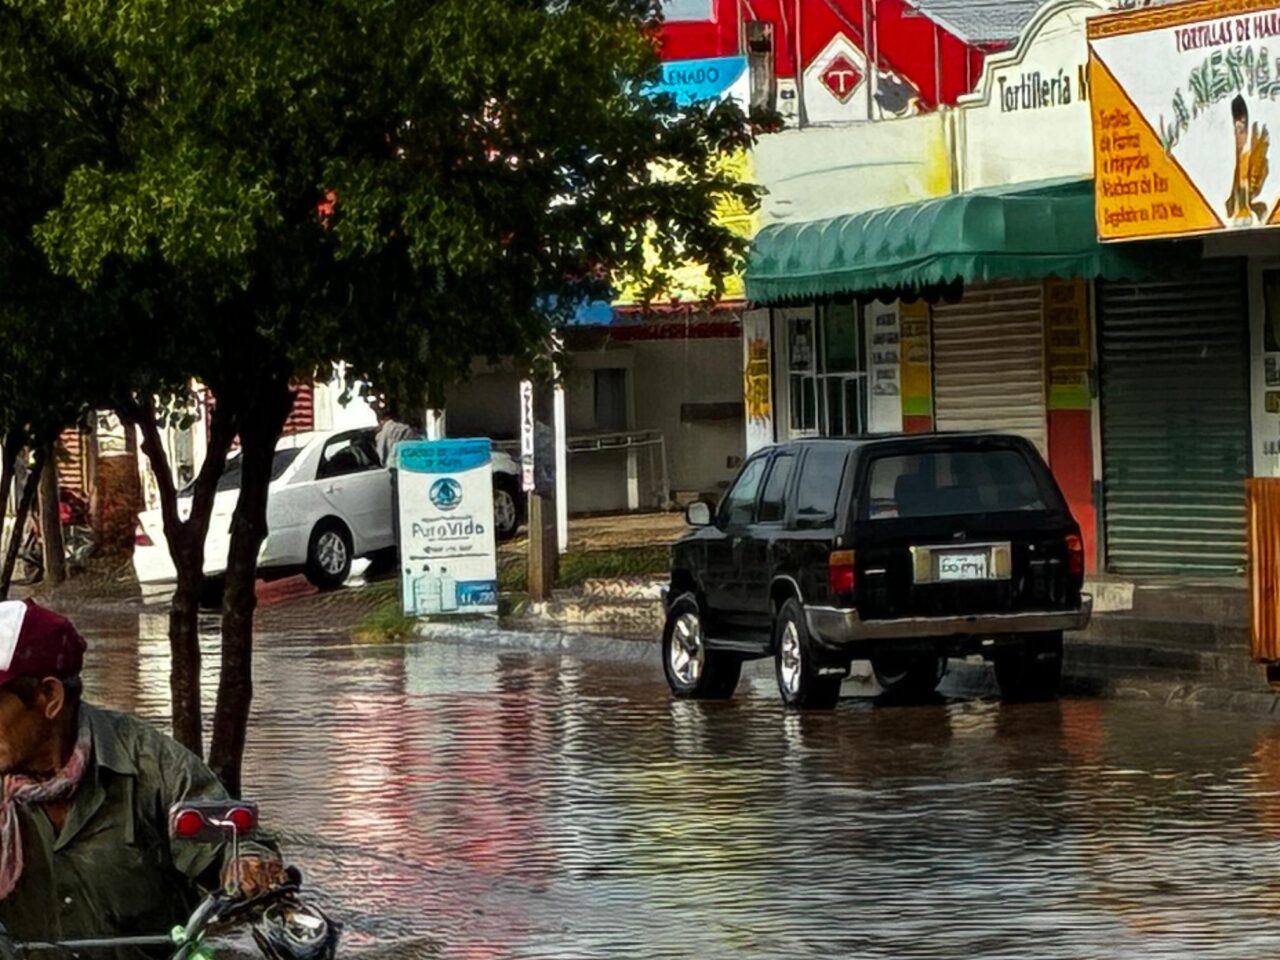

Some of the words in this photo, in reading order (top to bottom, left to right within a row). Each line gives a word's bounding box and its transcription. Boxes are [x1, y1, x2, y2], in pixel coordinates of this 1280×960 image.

[1175, 20, 1233, 52] TORTILLAS
[1235, 17, 1251, 42] DE
[997, 67, 1071, 113] Tortillería
